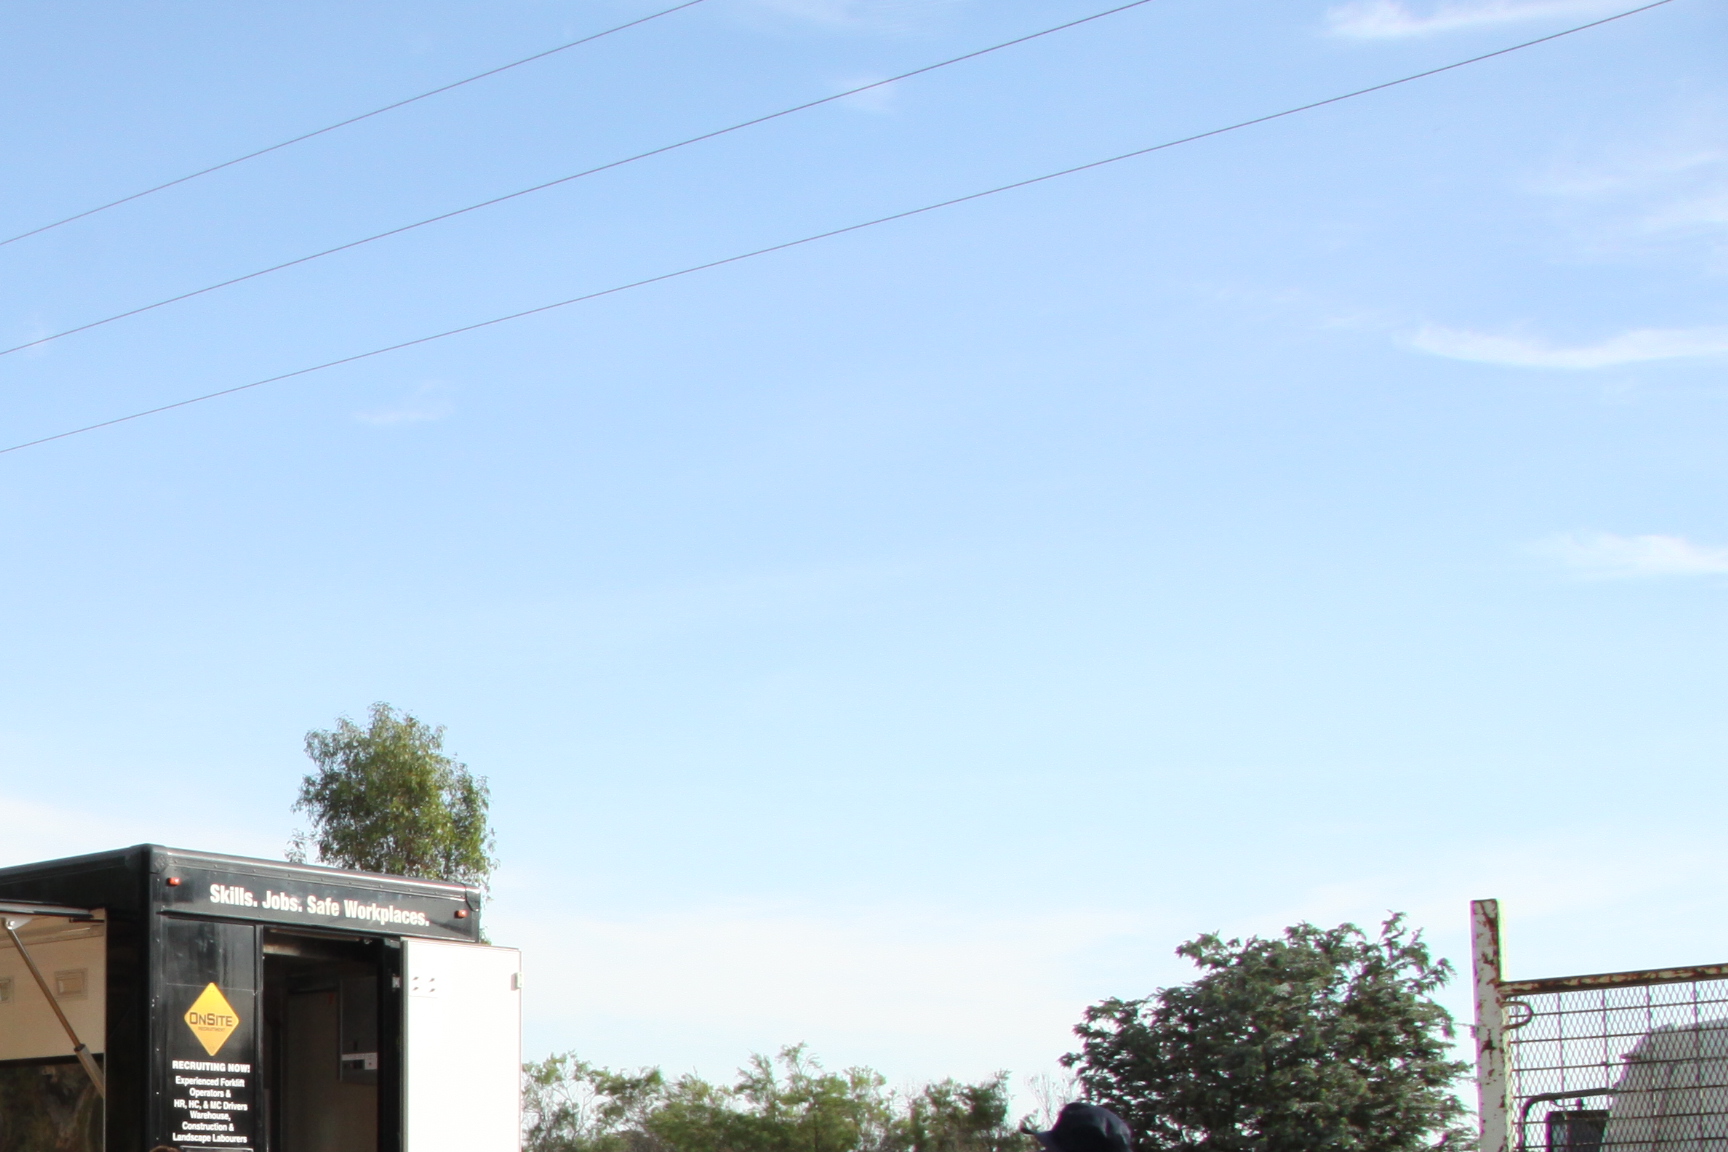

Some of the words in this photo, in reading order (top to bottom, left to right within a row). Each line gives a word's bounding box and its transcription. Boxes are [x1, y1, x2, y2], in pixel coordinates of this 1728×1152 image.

[210, 884, 258, 907] Skills.
[262, 891, 303, 912] Jobs.
[307, 895, 340, 916] Safe
[344, 899, 430, 927] Workplaces.
[172, 1060, 226, 1072] RECRUITING
[227, 1063, 251, 1073] NOW!
[175, 1075, 219, 1086] Experienced
[220, 1078, 245, 1087] Forklift
[189, 1087, 224, 1098] Operators
[225, 1089, 232, 1098] &
[173, 1099, 187, 1109] HR,
[188, 1100, 202, 1110] HC,
[203, 1100, 209, 1109] &
[210, 1100, 223, 1110] MC
[223, 1101, 248, 1111] Drivers
[189, 1110, 231, 1121] Warehouse,
[181, 1121, 228, 1131] Construction
[228, 1122, 235, 1131] &
[172, 1132, 212, 1144] Landscape
[212, 1133, 248, 1143] Labourers
